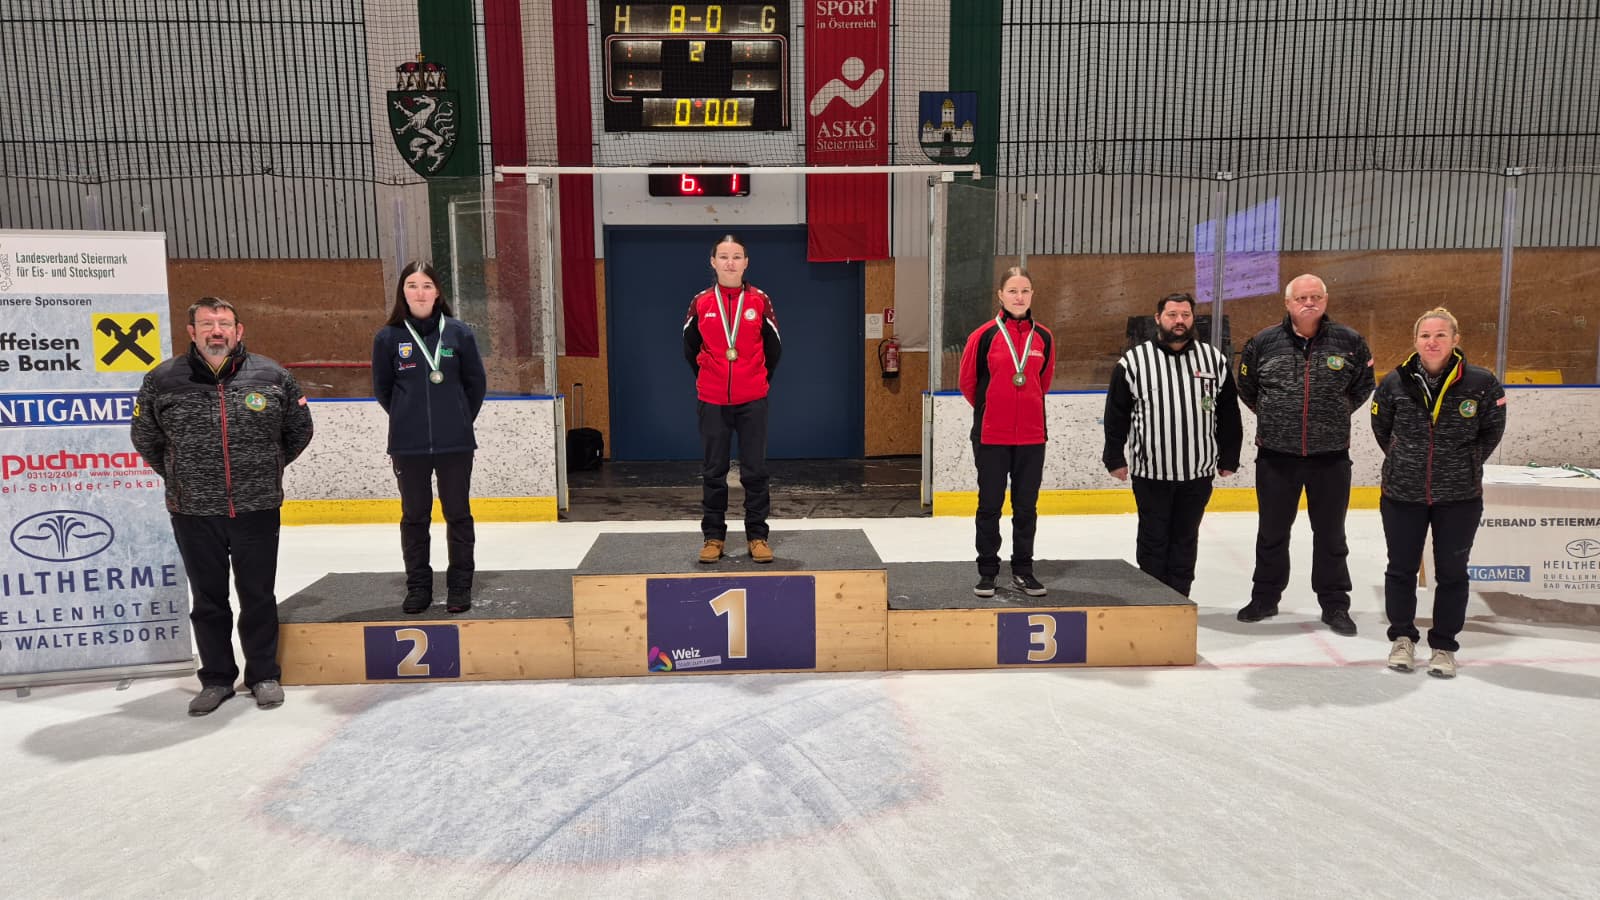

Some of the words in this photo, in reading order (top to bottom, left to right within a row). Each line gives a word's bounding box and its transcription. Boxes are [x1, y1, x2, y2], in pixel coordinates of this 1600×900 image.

[817, 0, 877, 16] SPORT
[615, 5, 630, 32] H
[760, 5, 776, 32] G
[817, 19, 826, 29] in
[828, 17, 877, 29] Österreich
[689, 42, 702, 62] 2
[817, 117, 876, 138] ASKÖ
[817, 138, 875, 150] Steiermark
[15, 252, 79, 264] Landesverband
[81, 253, 128, 264] Steiermark
[16, 266, 29, 278] für
[32, 266, 48, 278] Eis-
[52, 267, 67, 278] und
[69, 267, 115, 280] Stocksport
[34, 296, 92, 308] Sponsoren
[18, 353, 82, 372] Bank
[0, 396, 139, 423] NTIGAME
[1543, 560, 1600, 570] HEILTHE
[3, 564, 178, 597] ILTHERME
[0, 600, 179, 626] ELLENHOTEL
[708, 588, 748, 658] 1
[15, 625, 181, 651] WALTERSDORF
[1027, 614, 1058, 662] 3
[394, 628, 431, 677] 2
[672, 646, 701, 660] Weiz
